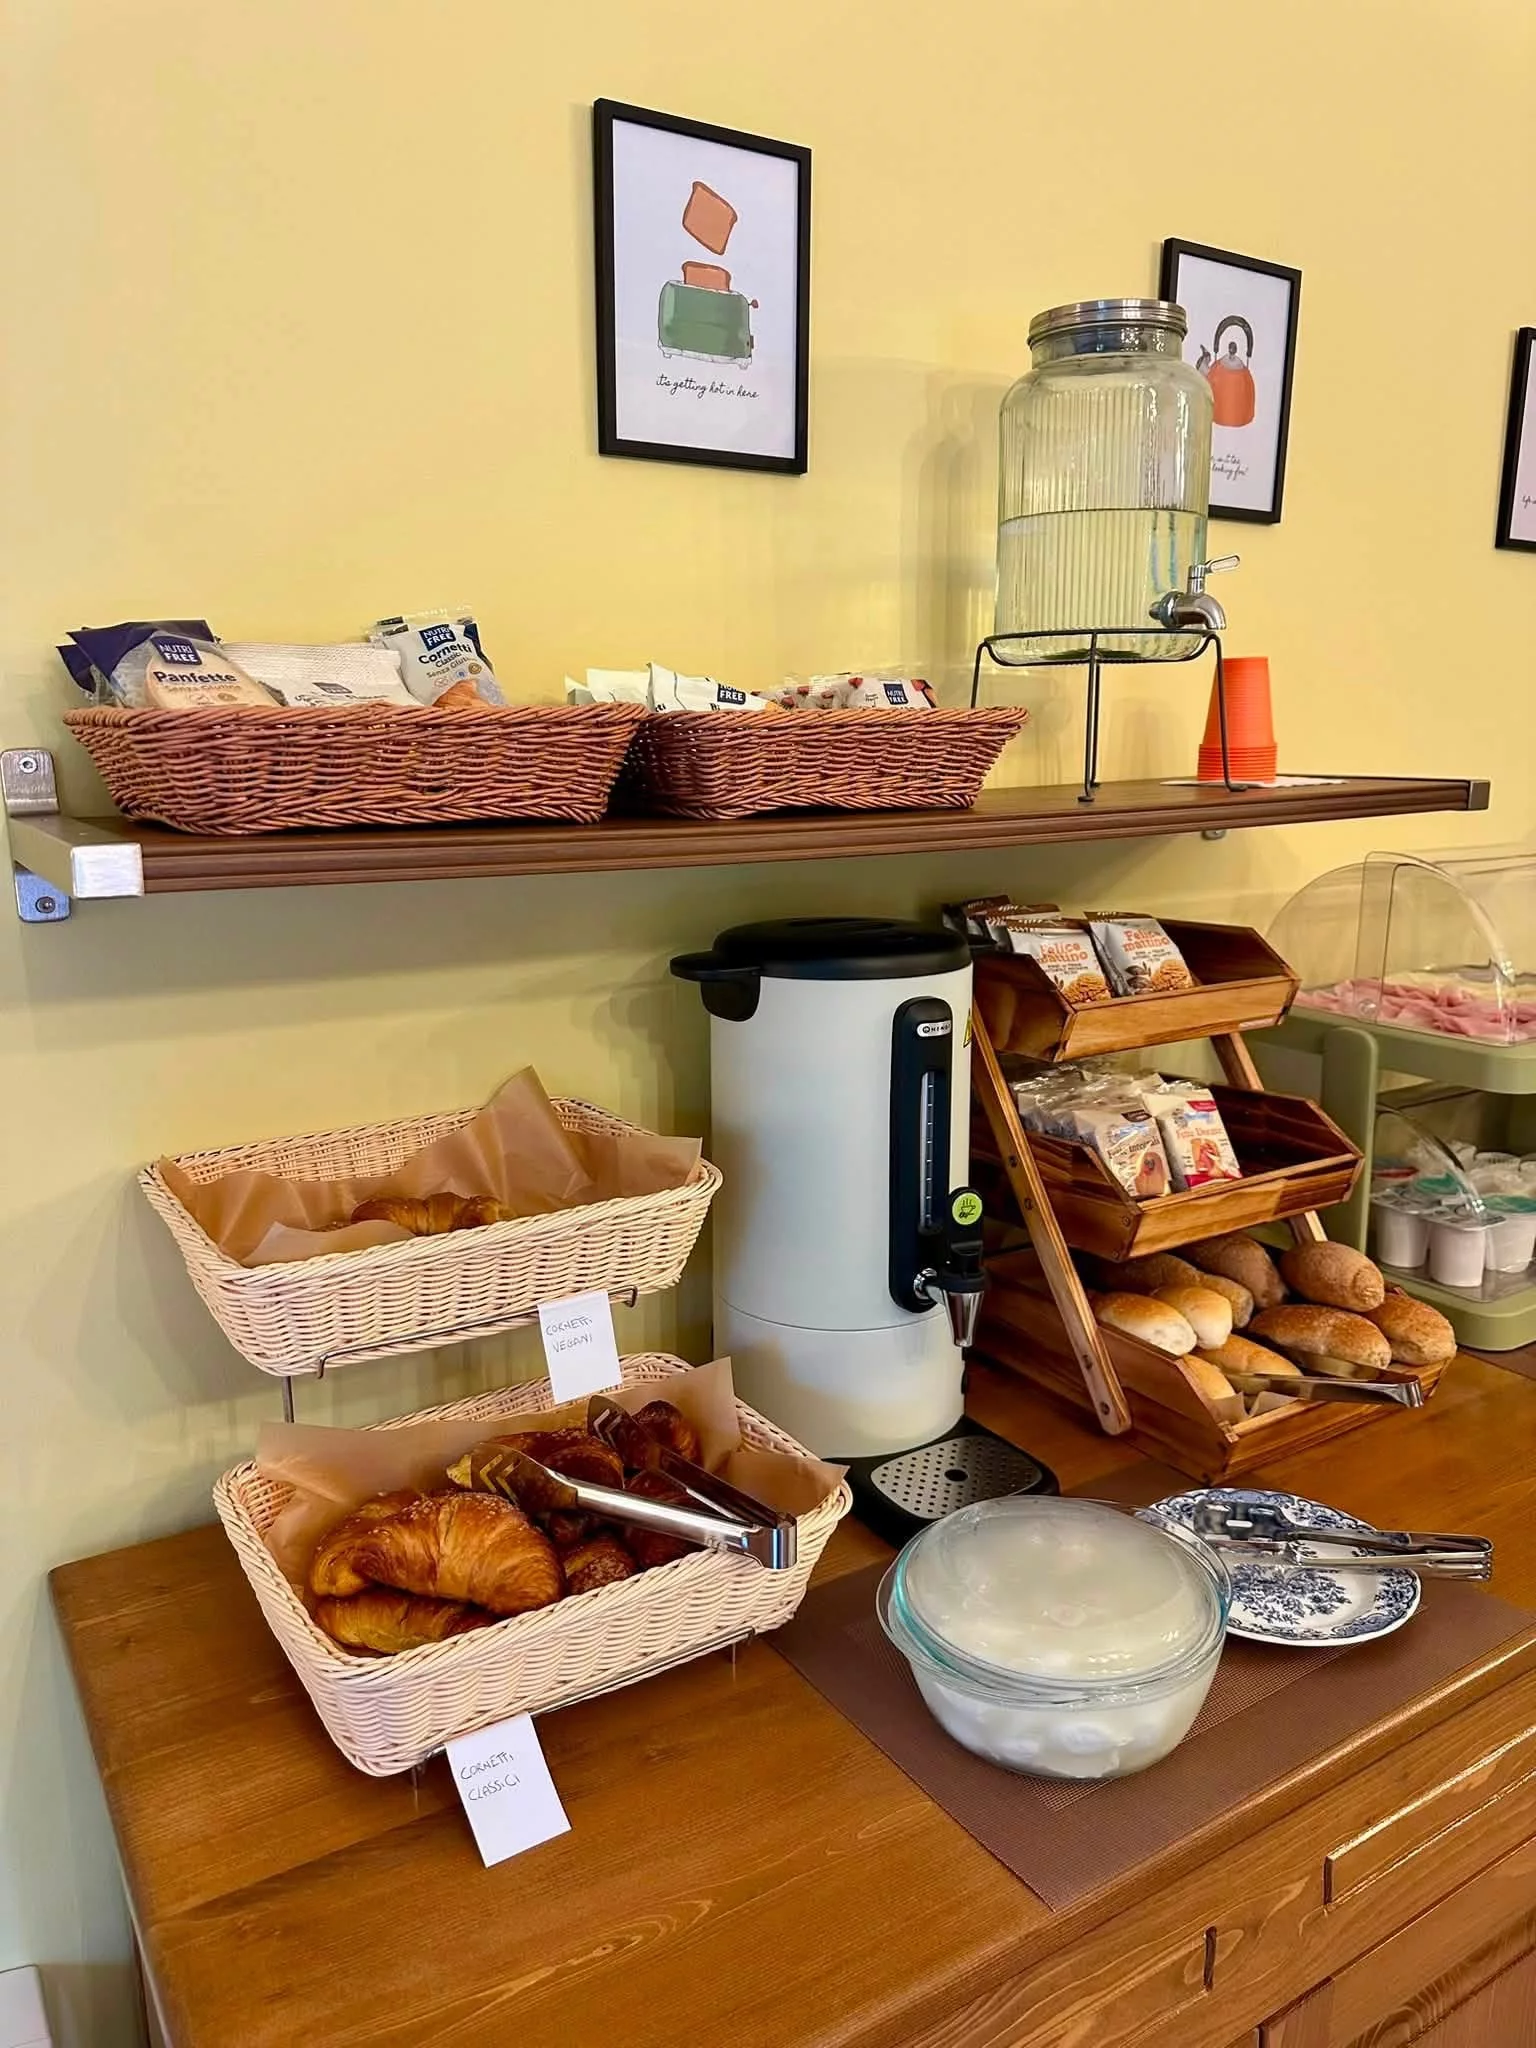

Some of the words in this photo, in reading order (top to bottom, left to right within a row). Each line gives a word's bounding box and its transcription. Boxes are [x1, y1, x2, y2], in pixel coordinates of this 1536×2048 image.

[670, 377, 707, 399] getting
[709, 381, 726, 394] hot
[726, 386, 735, 395] in
[737, 385, 759, 398] here
[423, 627, 450, 640] NUTRI
[427, 631, 454, 647] FREE
[160, 644, 193, 655] NUTRI
[164, 652, 198, 663] FREE
[418, 643, 473, 665] Cornetti
[153, 671, 238, 683] Panfette
[426, 666, 450, 679] Senza
[720, 690, 744, 702] FREE
[1123, 929, 1162, 942] Felice
[1123, 936, 1169, 953] mattino
[545, 1316, 593, 1336] CORNETTI
[552, 1333, 593, 1353] VEGANI
[460, 1751, 514, 1780] CORNETTI
[468, 1774, 521, 1801] CLASSICI
